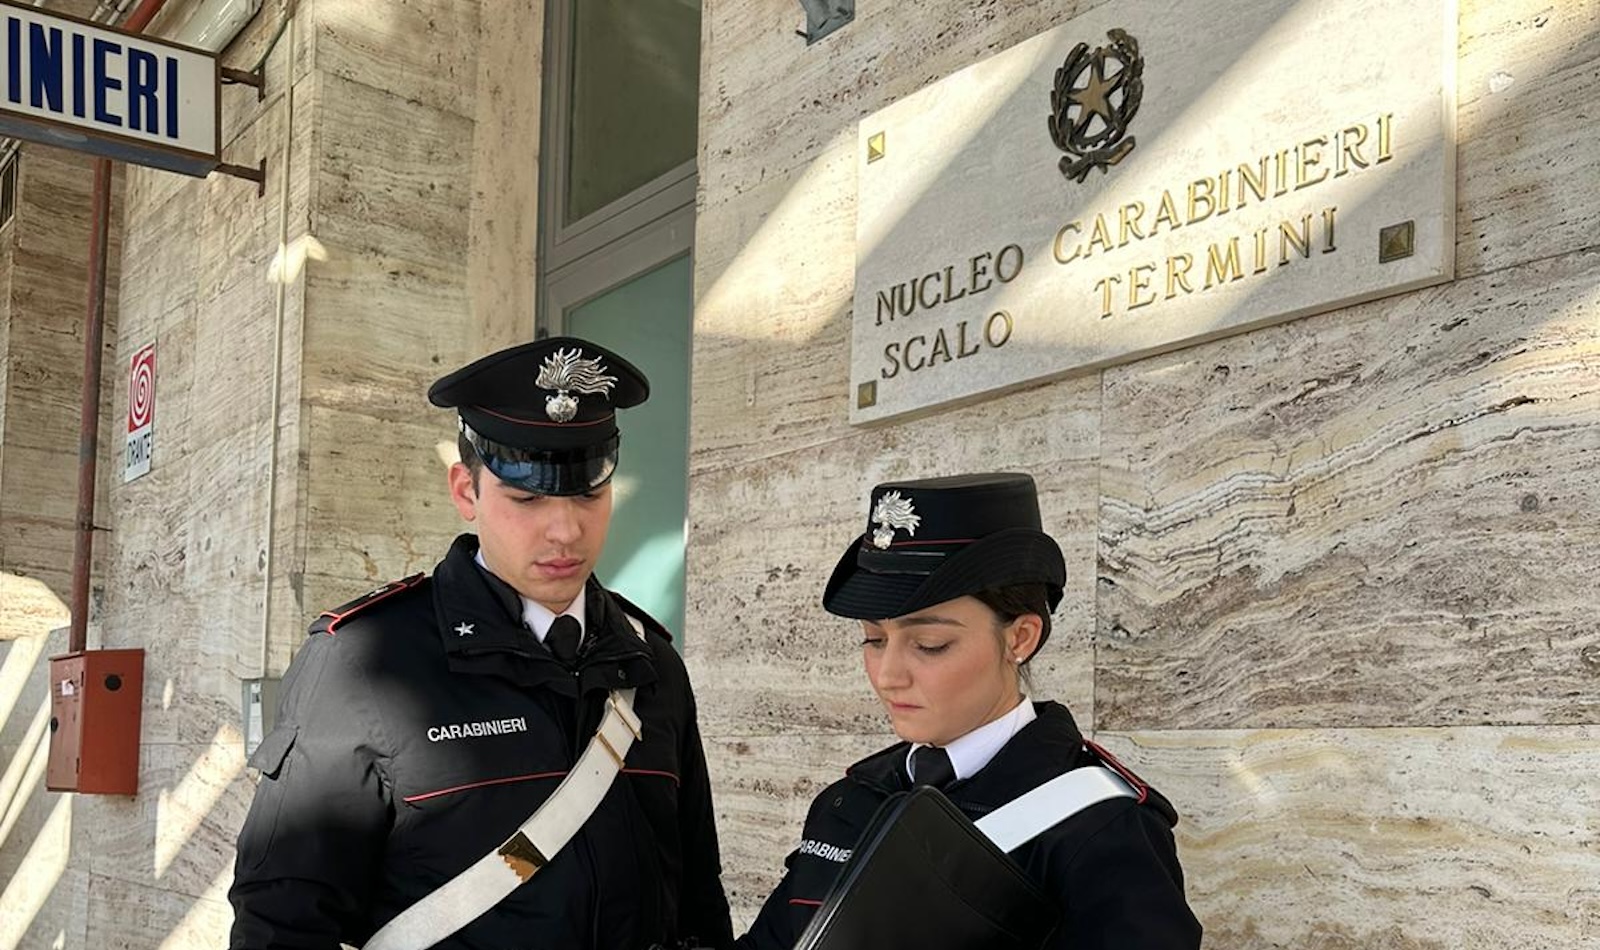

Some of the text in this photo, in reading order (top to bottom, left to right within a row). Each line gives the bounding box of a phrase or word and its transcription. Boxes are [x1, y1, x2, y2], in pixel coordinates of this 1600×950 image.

[8, 17, 178, 139] INIERI
[875, 112, 1394, 326] NUCLEO CARABINIERI
[881, 206, 1337, 379] SCALO TERMINI
[427, 717, 527, 742] CARABINIERI
